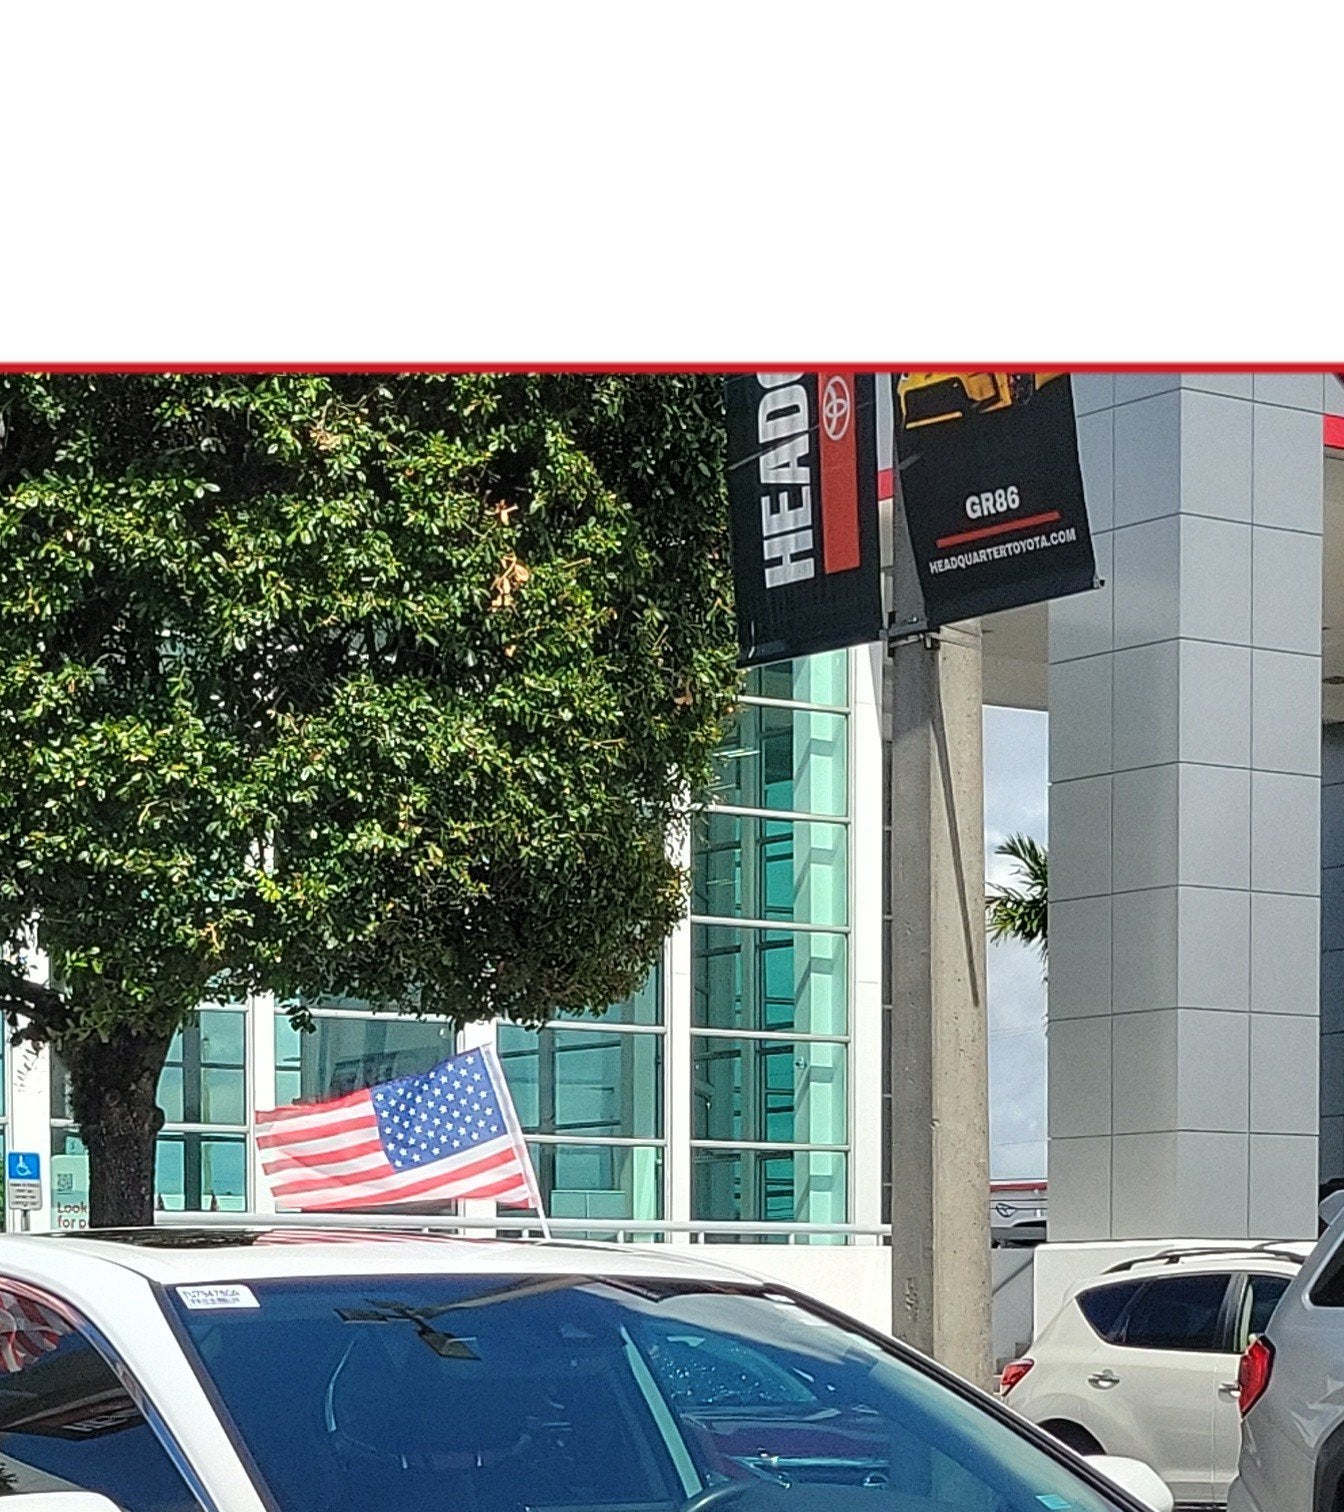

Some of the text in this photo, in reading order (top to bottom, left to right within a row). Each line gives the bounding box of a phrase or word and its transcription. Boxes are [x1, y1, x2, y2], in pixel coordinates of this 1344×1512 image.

[965, 485, 1020, 519] GR86
[929, 527, 1076, 574] HEADQUARTERTOYOTA.COM
[57, 1201, 87, 1214] Look
